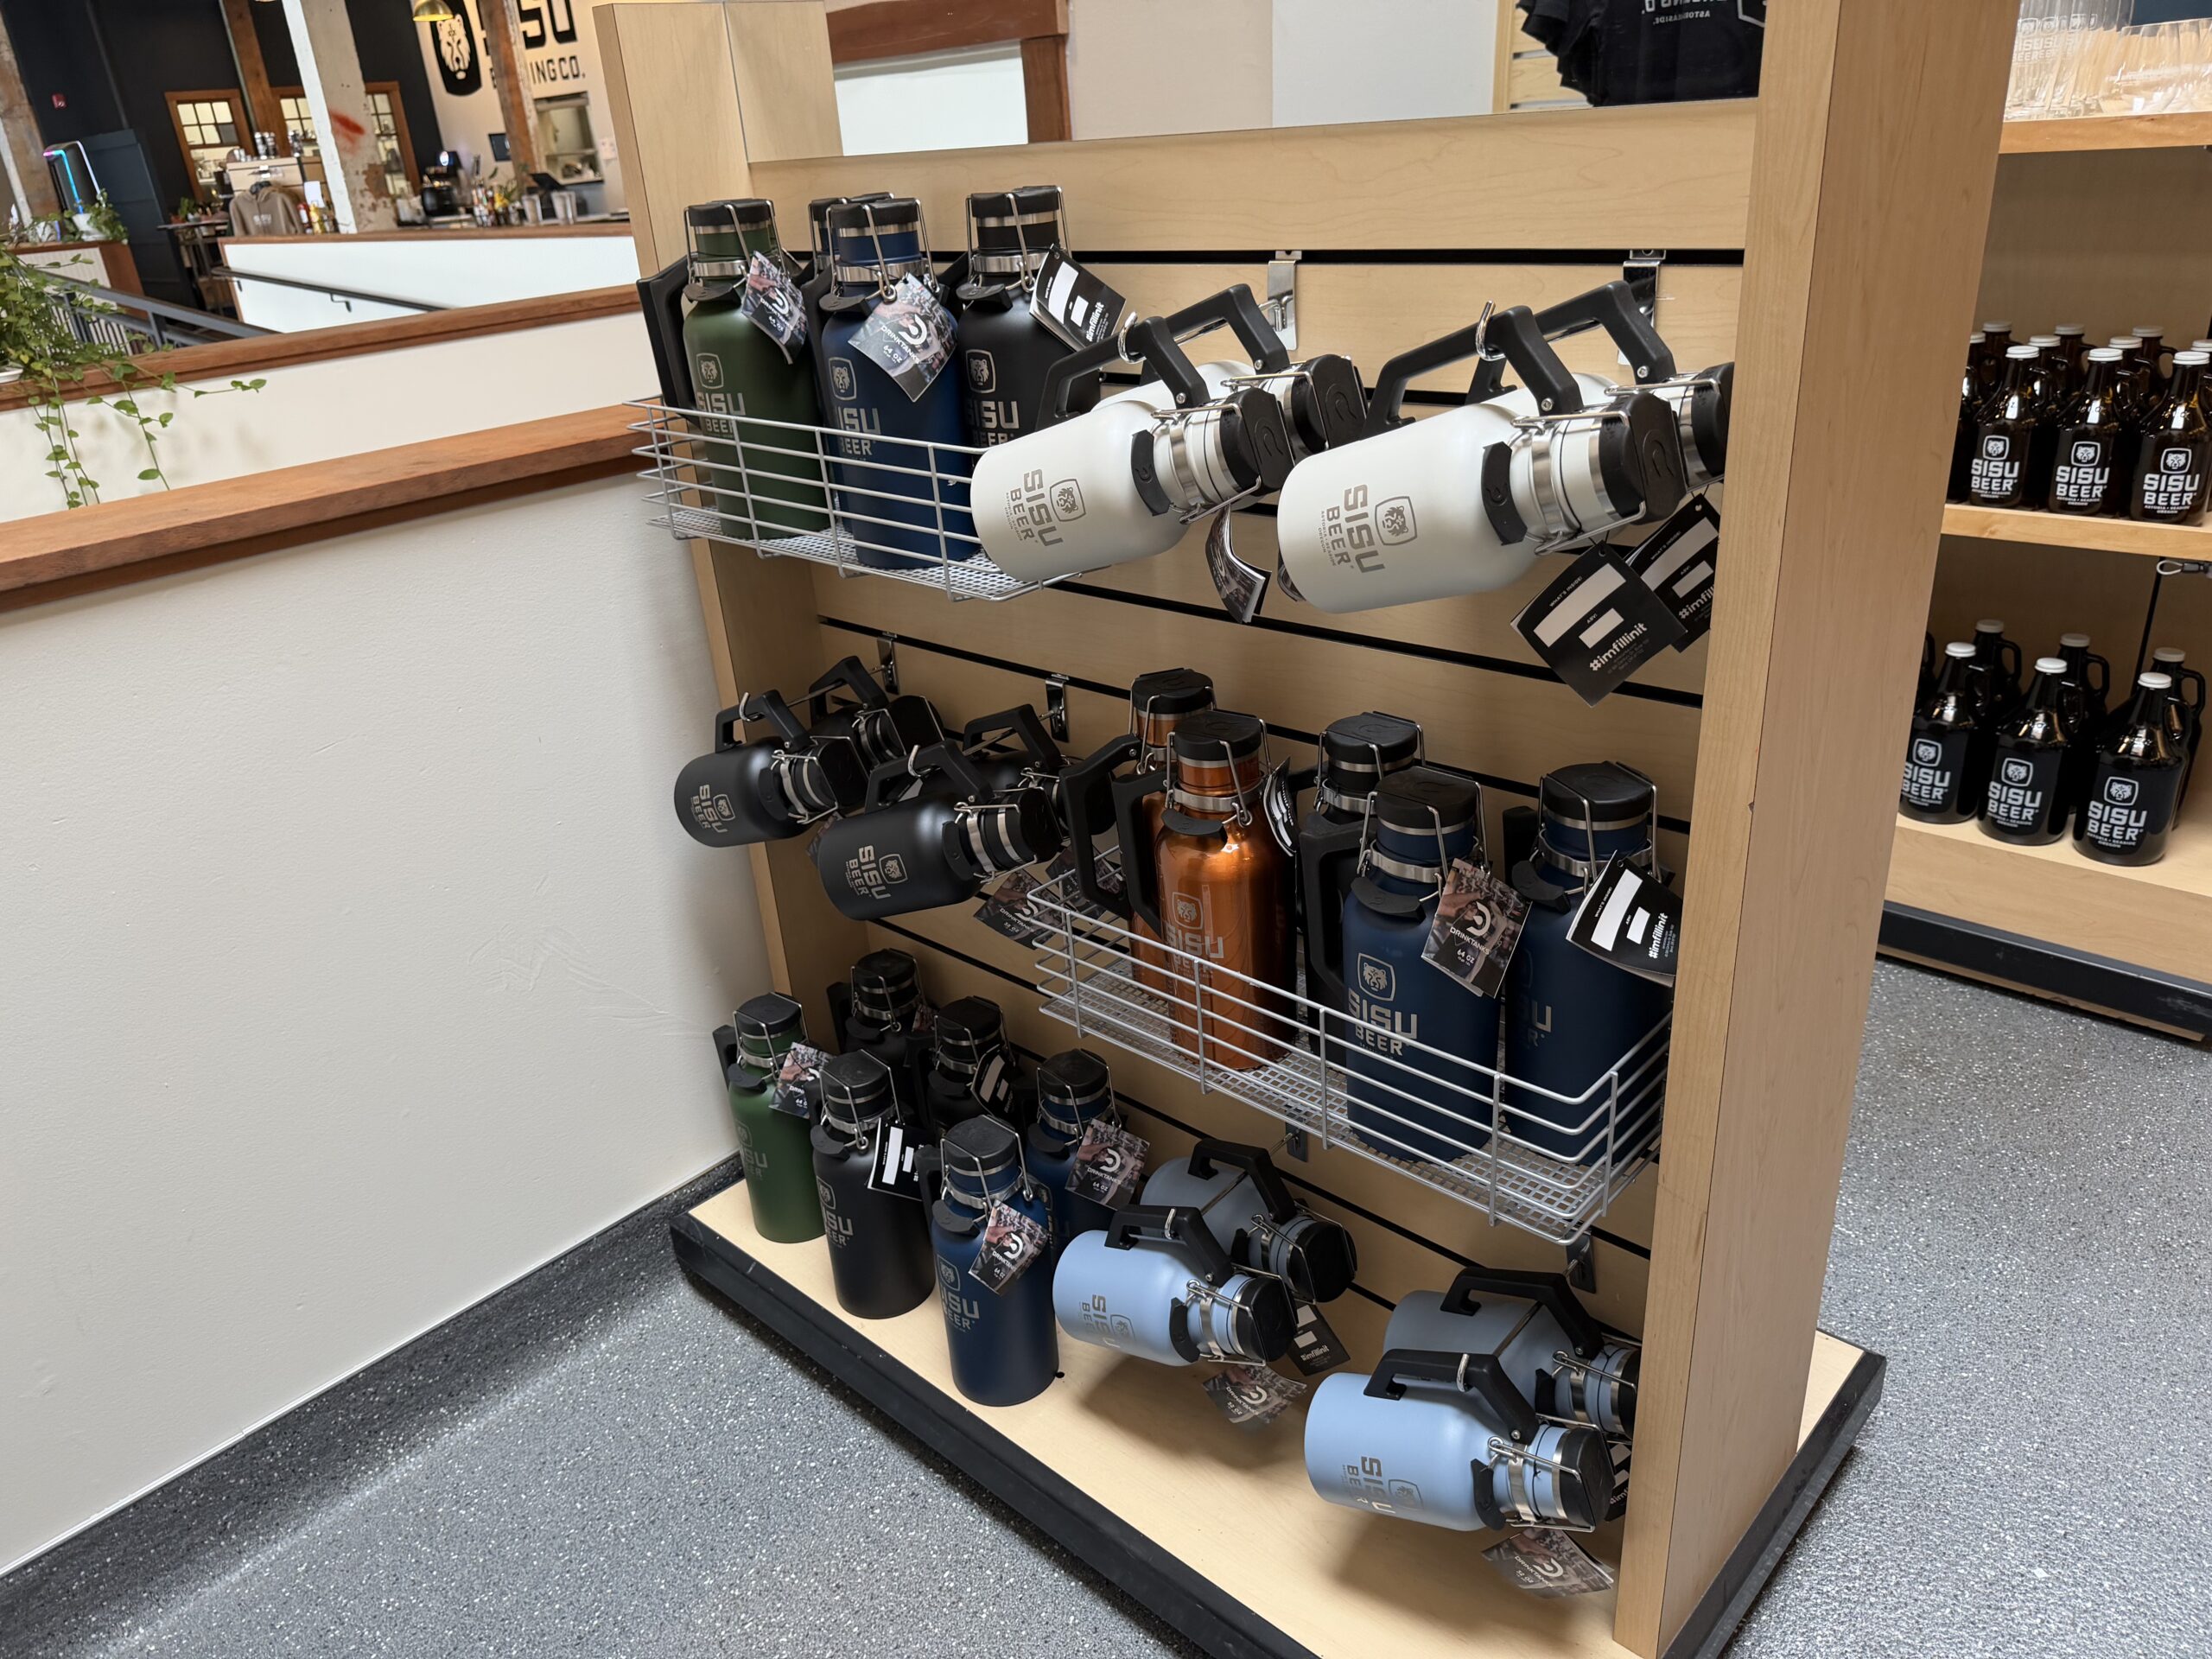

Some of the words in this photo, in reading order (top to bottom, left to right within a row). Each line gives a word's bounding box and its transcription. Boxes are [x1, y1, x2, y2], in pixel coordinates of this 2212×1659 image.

[881, 325, 920, 364] DRINKTANKS
[883, 345, 893, 353] 64
[893, 353, 903, 363] OZ
[1970, 458, 2020, 478] SISU
[2055, 465, 2110, 484] SISU
[2143, 473, 2201, 492] SISU
[1971, 475, 2012, 491] BEER
[2056, 483, 2102, 499] BEER
[1023, 468, 1064, 547] SISU
[2143, 491, 2192, 505] BEER
[1010, 487, 1035, 540] BEER
[1326, 505, 1351, 565] BEER
[1344, 484, 1385, 573] SISU
[1589, 622, 1648, 671] #imfillinit
[699, 784, 728, 833] SISU
[1987, 780, 2043, 808] SISU
[1987, 798, 2034, 821] BEER
[2088, 800, 2147, 827] SISU
[2088, 818, 2138, 841] BEER
[849, 859, 869, 895] BEER
[859, 845, 891, 899] SISU
[1449, 926, 1490, 955] DRINKTANKS
[1648, 912, 1669, 958] #imfillinit
[1457, 948, 1465, 958] 64
[1465, 955, 1476, 964] OZ
[1349, 988, 1417, 1039] SISU
[1355, 1024, 1403, 1057] BEER
